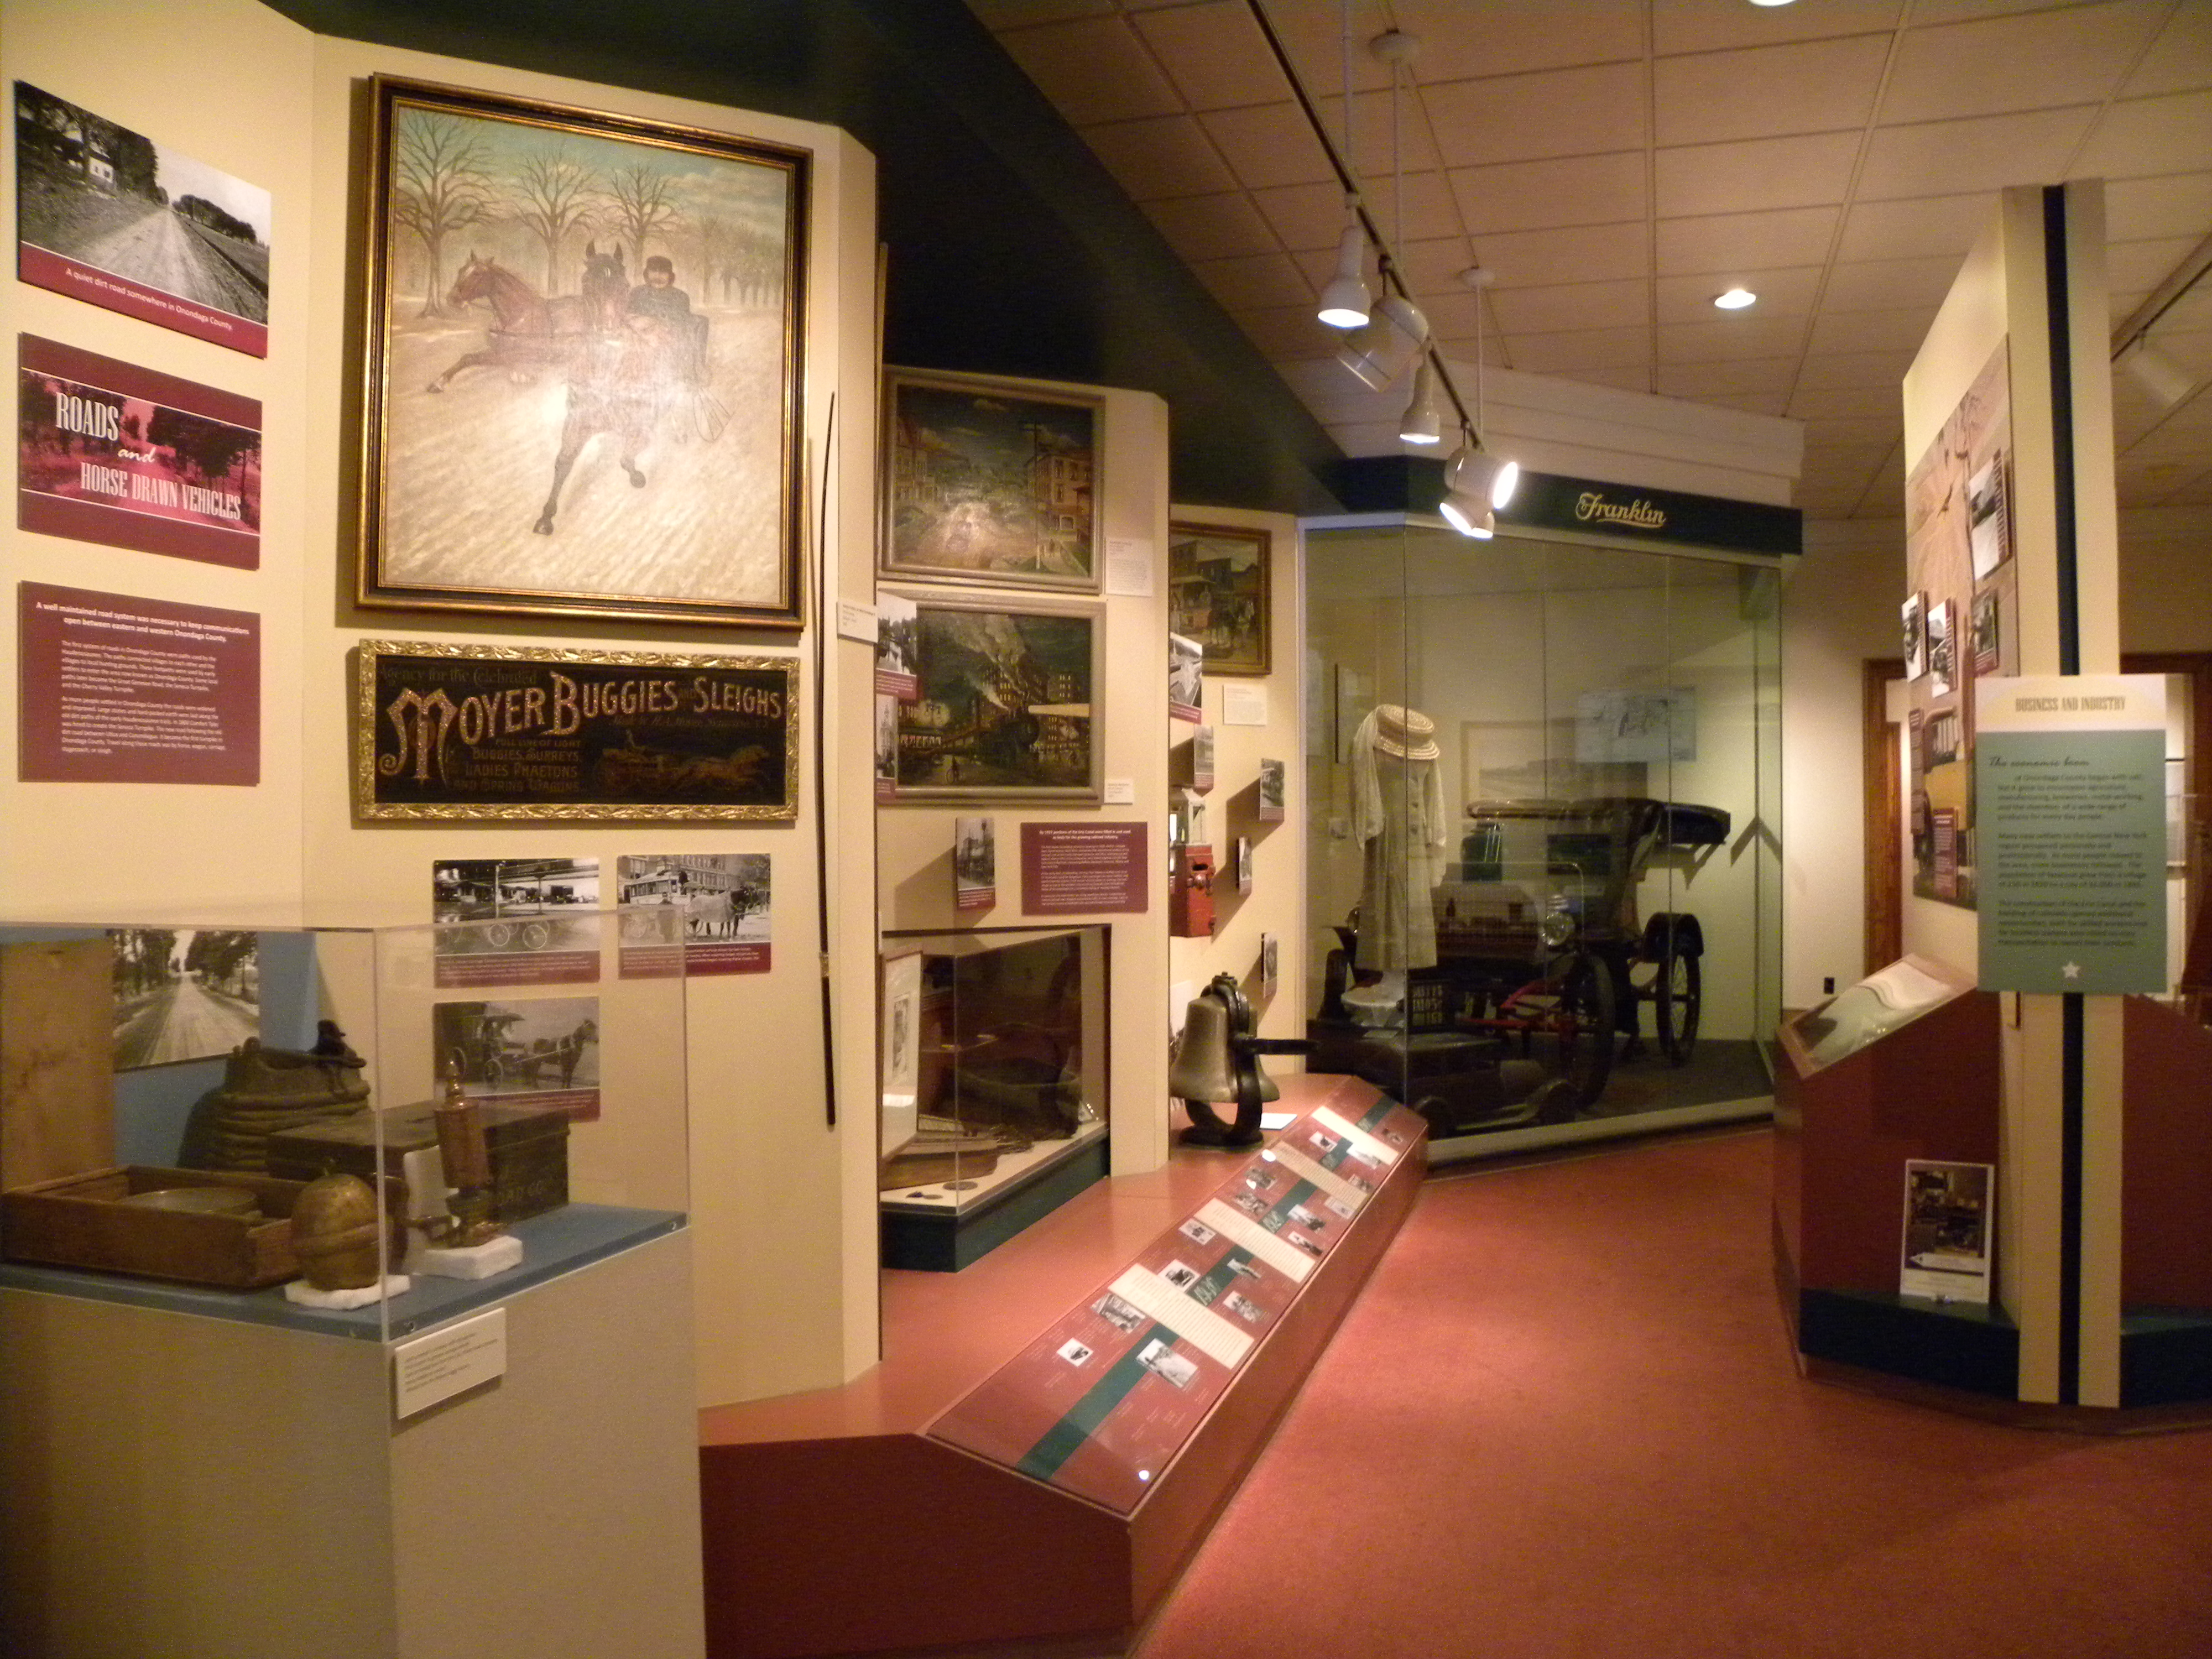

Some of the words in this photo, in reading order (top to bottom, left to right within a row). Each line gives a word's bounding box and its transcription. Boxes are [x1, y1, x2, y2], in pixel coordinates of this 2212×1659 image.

[66, 268, 72, 276] A
[74, 271, 93, 284] quiet
[95, 279, 108, 289] dirt
[109, 284, 126, 295] road
[127, 289, 167, 308] somewhere
[168, 302, 175, 310] in
[176, 305, 209, 323] Onondaga
[55, 391, 119, 441] ROADS
[118, 446, 156, 463] and
[80, 462, 128, 498] HORSE
[132, 473, 178, 509] DRAWN
[181, 483, 242, 520] VEHICLES
[1575, 492, 1666, 528] Franklin
[2015, 697, 2058, 712] BUSINESS
[2062, 697, 2078, 711] AND
[2081, 696, 2126, 711] INDUSTRY
